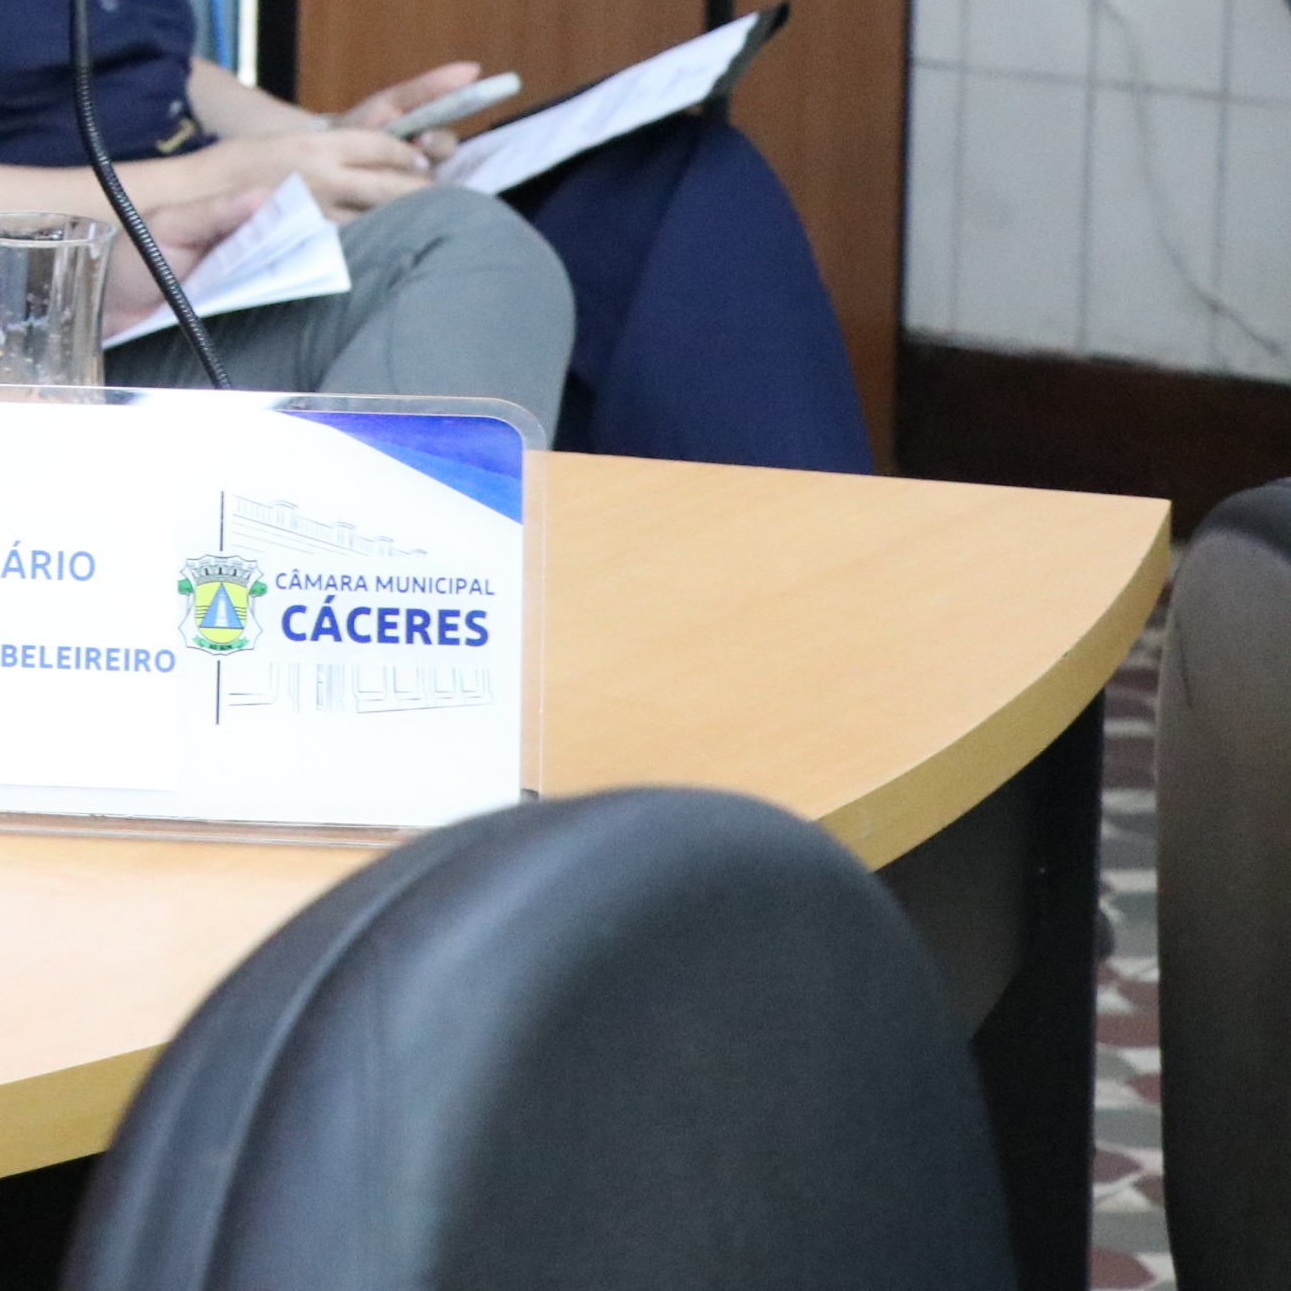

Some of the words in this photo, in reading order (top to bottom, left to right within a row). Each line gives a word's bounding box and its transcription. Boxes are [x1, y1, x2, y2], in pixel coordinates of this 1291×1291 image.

[275, 568, 369, 592] CÂMARA
[375, 575, 496, 596] MUNICIPAL
[281, 594, 489, 647] CÁCERES
